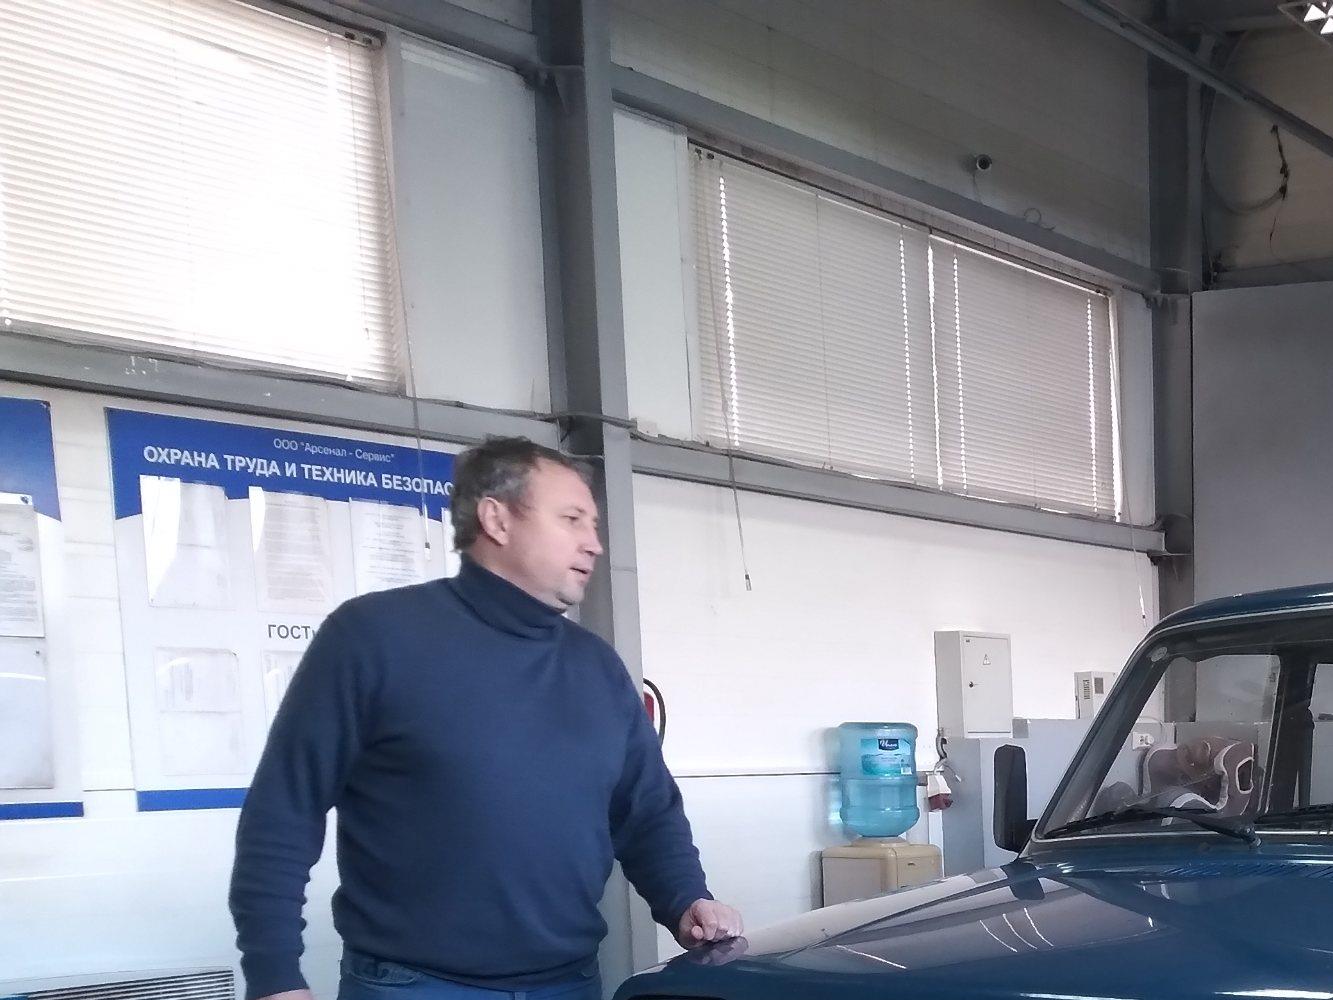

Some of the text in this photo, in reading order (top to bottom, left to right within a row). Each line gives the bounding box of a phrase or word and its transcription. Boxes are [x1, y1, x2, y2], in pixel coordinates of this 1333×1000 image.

[273, 438, 298, 451] ООО
[143, 445, 456, 497] ОХРАНА ТРУДА И ТЕХНИКА БЕЗОПАС
